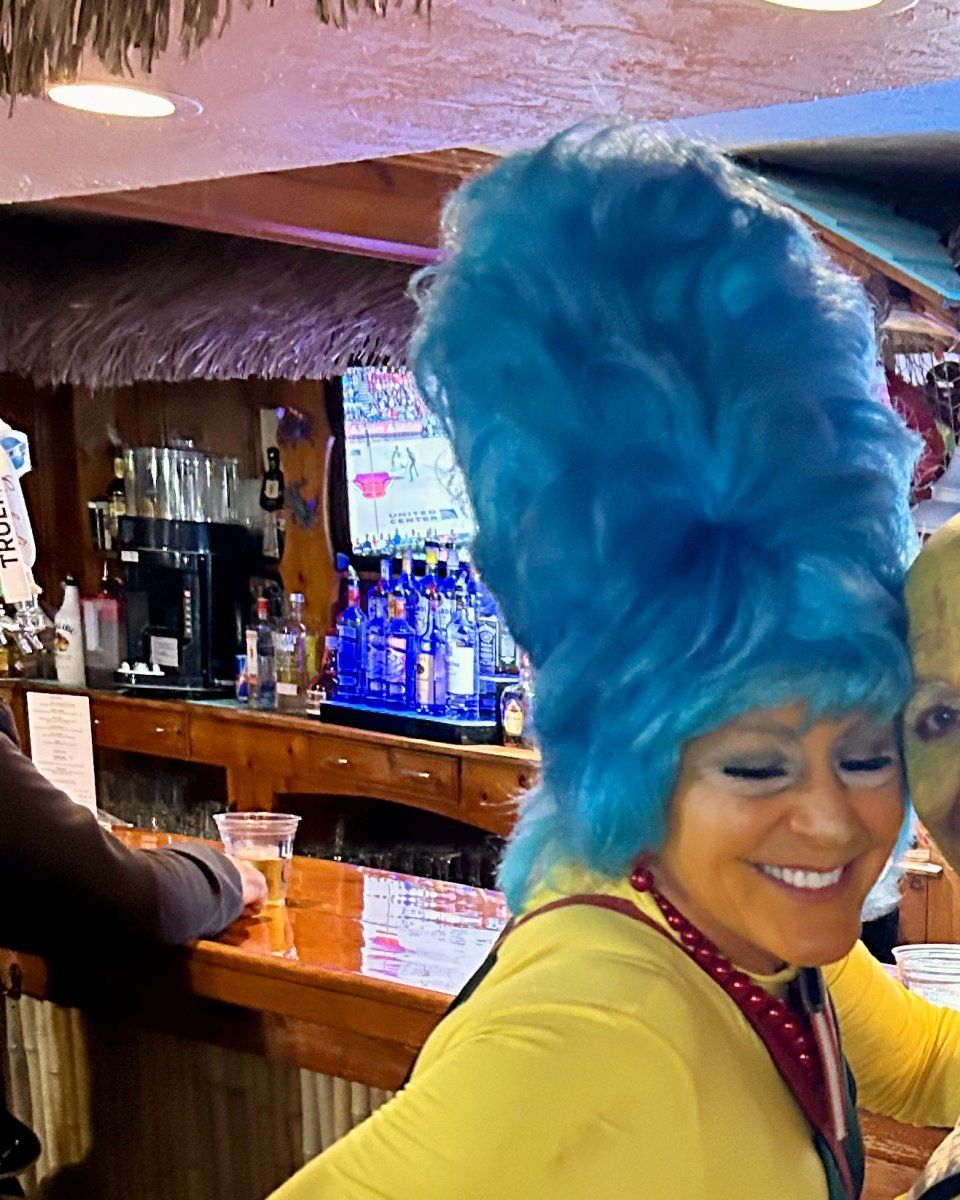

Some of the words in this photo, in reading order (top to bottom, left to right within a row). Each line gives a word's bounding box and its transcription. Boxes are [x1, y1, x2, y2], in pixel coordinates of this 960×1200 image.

[389, 510, 436, 518] UNITED
[390, 516, 437, 525] CENTER
[0, 500, 18, 569] TRUL
